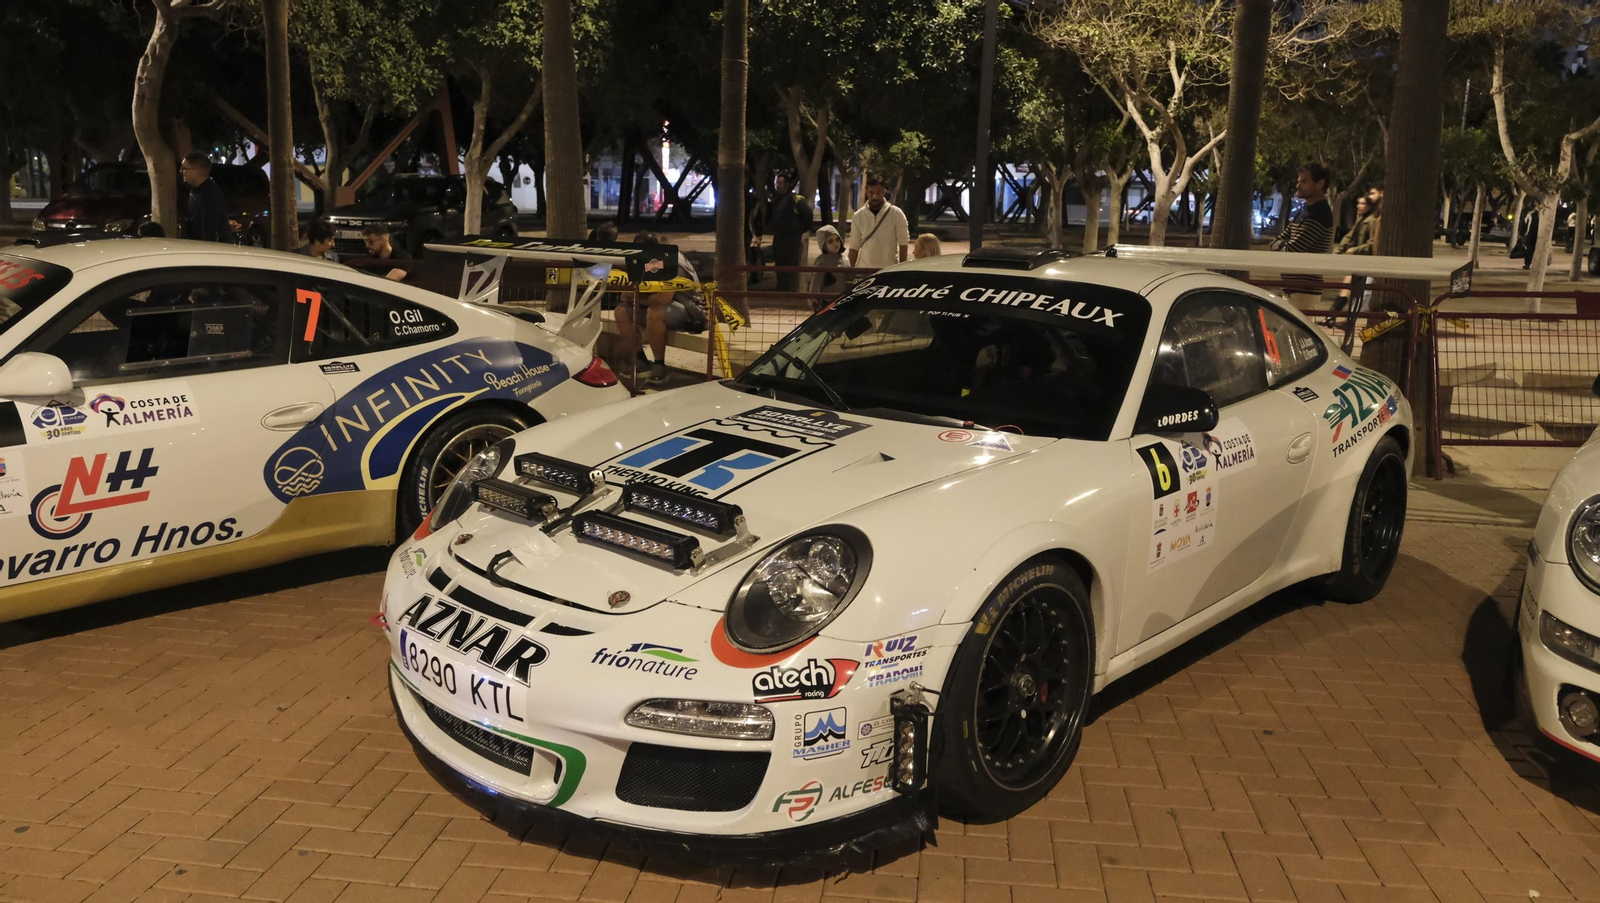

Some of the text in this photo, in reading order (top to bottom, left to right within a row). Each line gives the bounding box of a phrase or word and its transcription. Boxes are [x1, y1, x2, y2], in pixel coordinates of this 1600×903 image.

[513, 241, 643, 255] Carbono
[296, 288, 321, 342] 7
[389, 310, 423, 325] O.Gil
[866, 284, 953, 299] André
[959, 286, 1124, 328] CHIPEAUX
[394, 323, 440, 336] C.Chamorro
[484, 364, 550, 390] Beach House
[130, 395, 188, 409] COSTA DE
[320, 350, 493, 451] INFINITY
[122, 404, 193, 426] ALMERÍA
[1158, 411, 1198, 427] LOURDES
[46, 428, 60, 440] 30
[1223, 434, 1251, 450] COSTA DE
[1222, 445, 1255, 469] ALMERÍA
[607, 465, 668, 487] THERMO
[418, 466, 428, 520] ICHELIN
[131, 517, 244, 557] Hnos.
[997, 565, 1054, 607] MICHELIN
[396, 592, 550, 688] AZNAR
[865, 635, 918, 658] RUIZ
[865, 650, 928, 668] TRANSPORTES
[409, 642, 457, 695] 8290
[471, 673, 524, 722] KTL
[754, 659, 836, 690] atech
[805, 690, 825, 698] racing
[794, 714, 802, 747] GRUPO
[793, 740, 851, 756] MASHER
